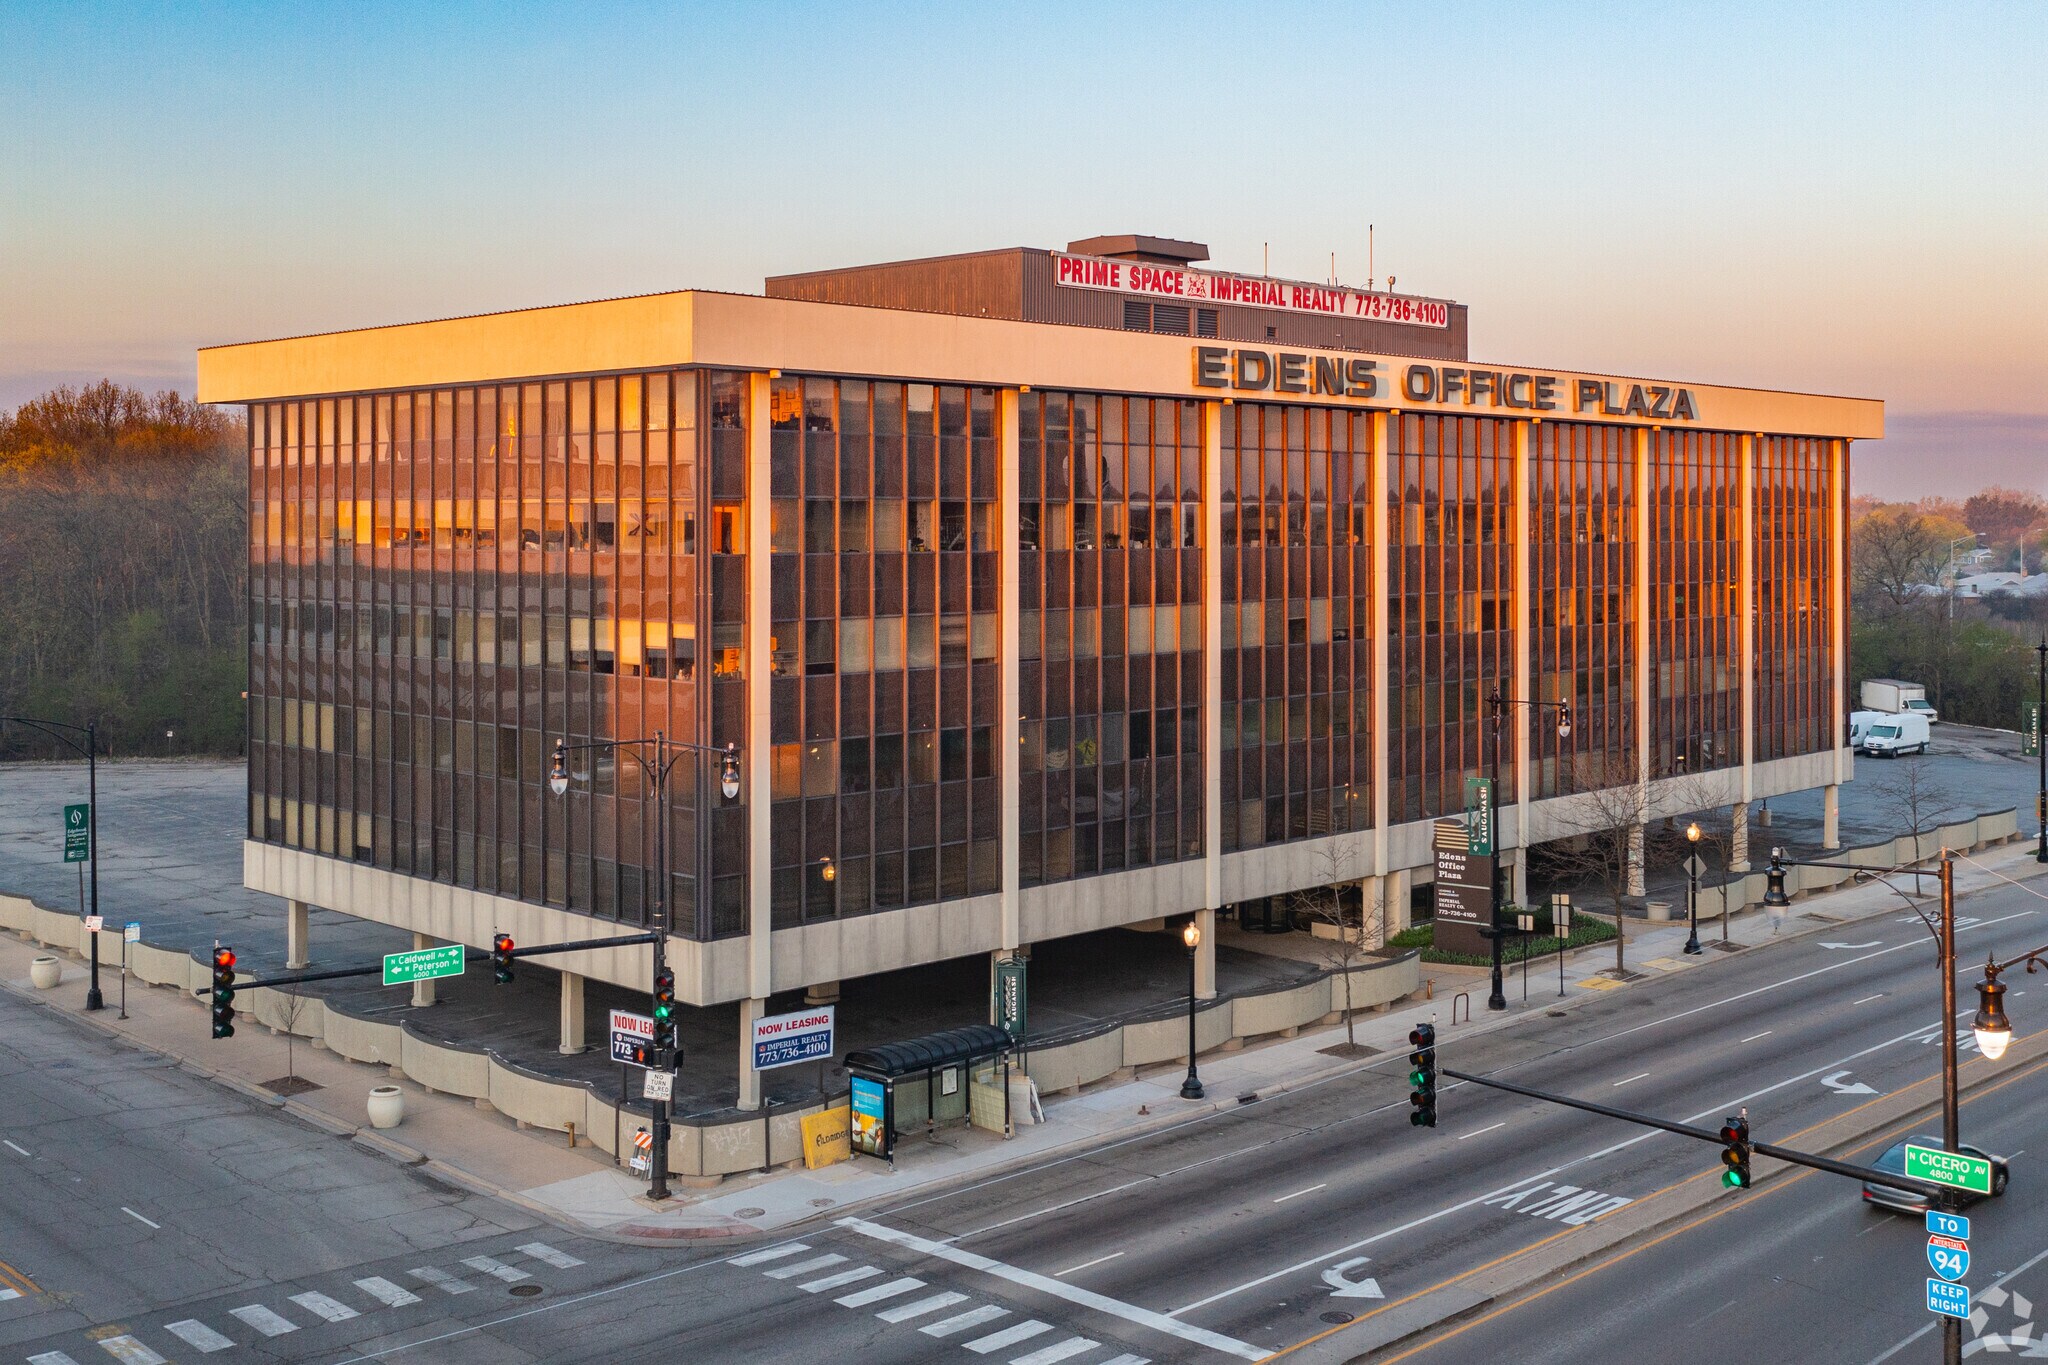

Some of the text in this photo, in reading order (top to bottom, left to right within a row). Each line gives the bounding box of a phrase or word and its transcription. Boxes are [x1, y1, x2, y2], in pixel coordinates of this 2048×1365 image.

[1060, 258, 1446, 326] PRIME SPACE IMPERIAL REALTY 773-736-4100
[1192, 346, 1695, 419] EDENS OFFICE PLAZA
[1438, 852, 1466, 861] Edens
[1438, 861, 1466, 871] Office
[1438, 870, 1462, 880] Plaza
[399, 952, 435, 965] Caldwell
[412, 960, 449, 972] Peterson
[614, 1015, 637, 1031] NOW
[758, 1015, 829, 1036] NOW LEASING
[767, 1033, 828, 1051] IMPERIAL REALTY
[759, 1041, 827, 1064] 773/736-4100
[651, 1079, 666, 1087] TURN
[1909, 1152, 1986, 1175] N CICERO AV
[1929, 1169, 1965, 1183] 4800 W
[1483, 1181, 1634, 1226] ONLY
[1938, 1217, 1958, 1233] TO
[1933, 1238, 1963, 1250] INTERSTATE
[1934, 1250, 1962, 1274] 94
[1932, 1283, 1964, 1299] KEEP
[1930, 1296, 1966, 1314] RIGHT
